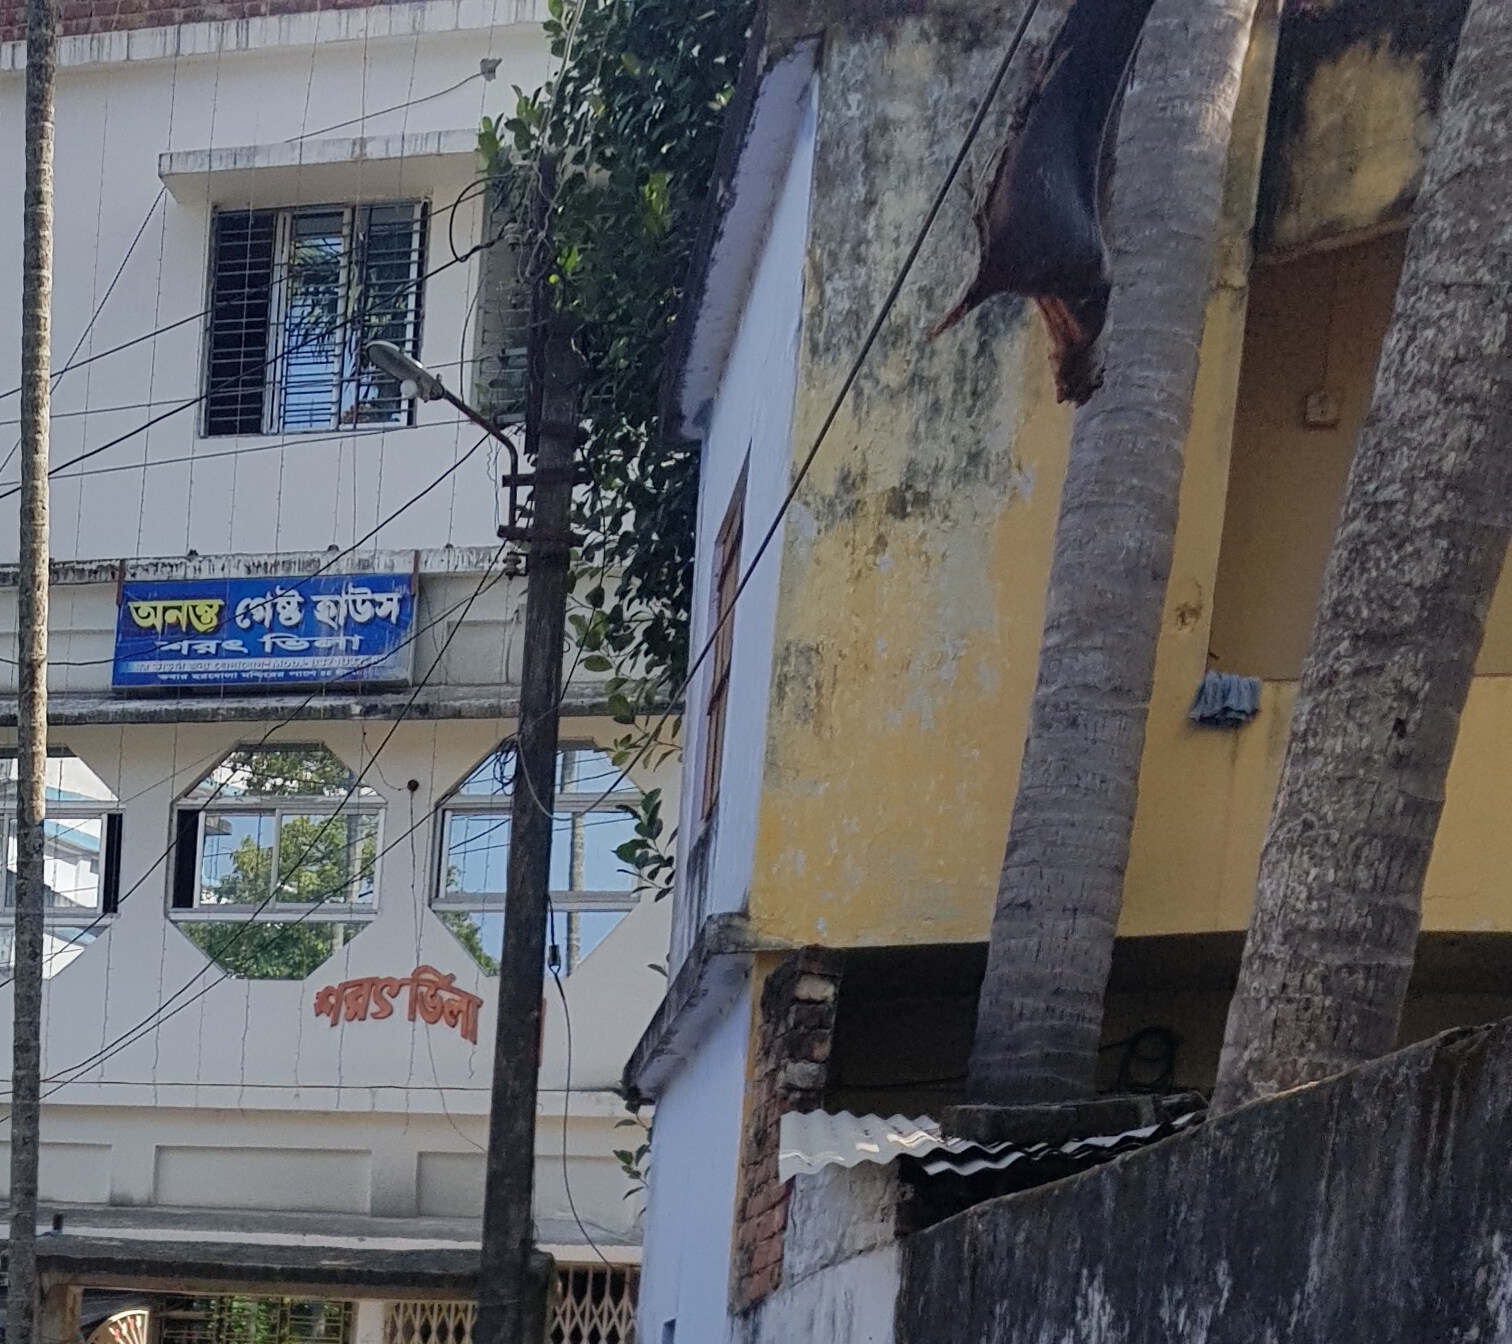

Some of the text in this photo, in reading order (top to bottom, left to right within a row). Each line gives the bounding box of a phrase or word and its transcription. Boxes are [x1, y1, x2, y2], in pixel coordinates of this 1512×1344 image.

[127, 598, 225, 633] অনন্ত
[310, 582, 402, 630] হাউস
[155, 632, 365, 655] শরৎ ভিলা
[400, 964, 484, 1046] ভিলা
